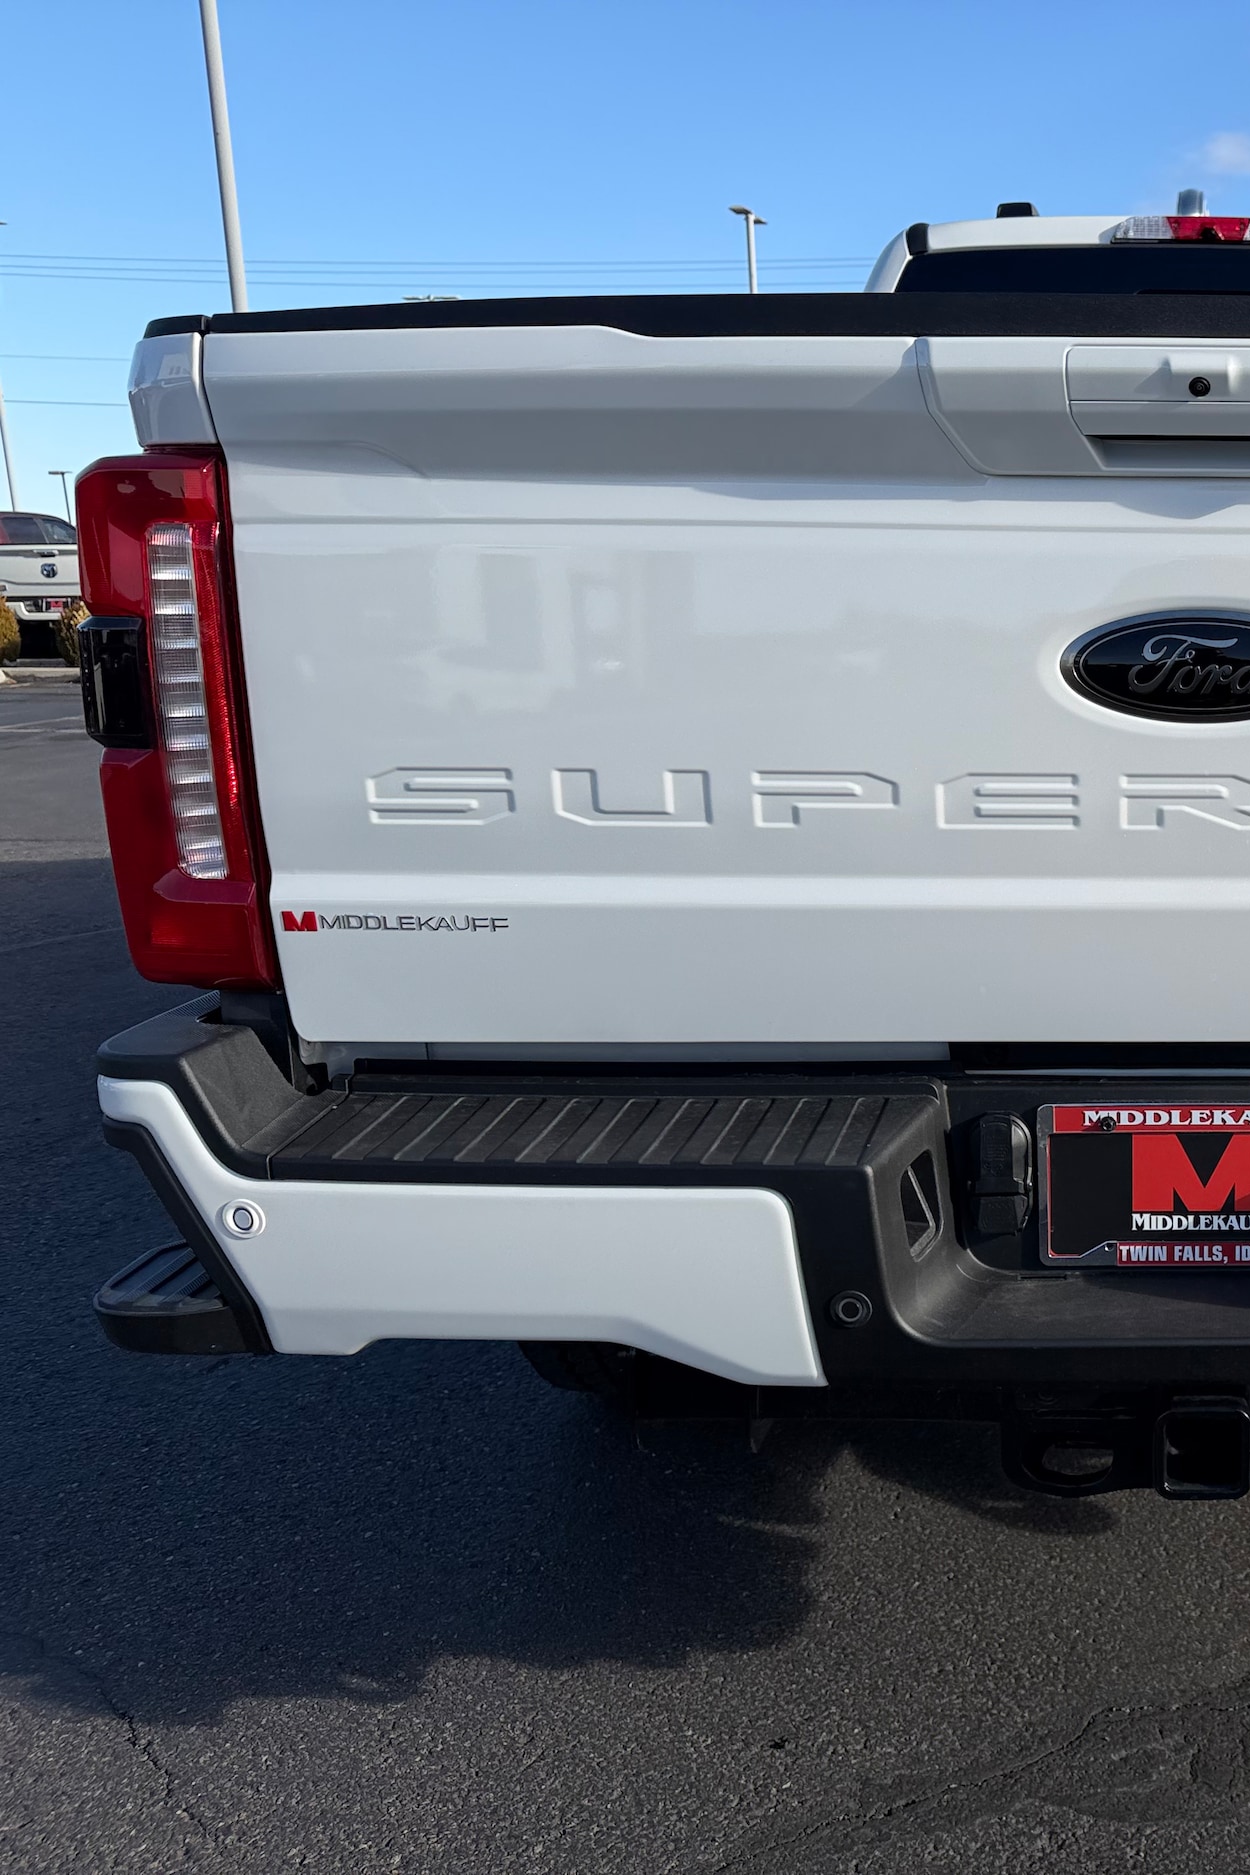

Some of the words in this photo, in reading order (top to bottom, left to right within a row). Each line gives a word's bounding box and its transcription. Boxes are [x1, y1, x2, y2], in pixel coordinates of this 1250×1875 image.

[319, 914, 509, 932] MIDDLEKAUFF
[1119, 1245, 1167, 1262] TWIN
[1173, 1245, 1229, 1264] FALLS,
